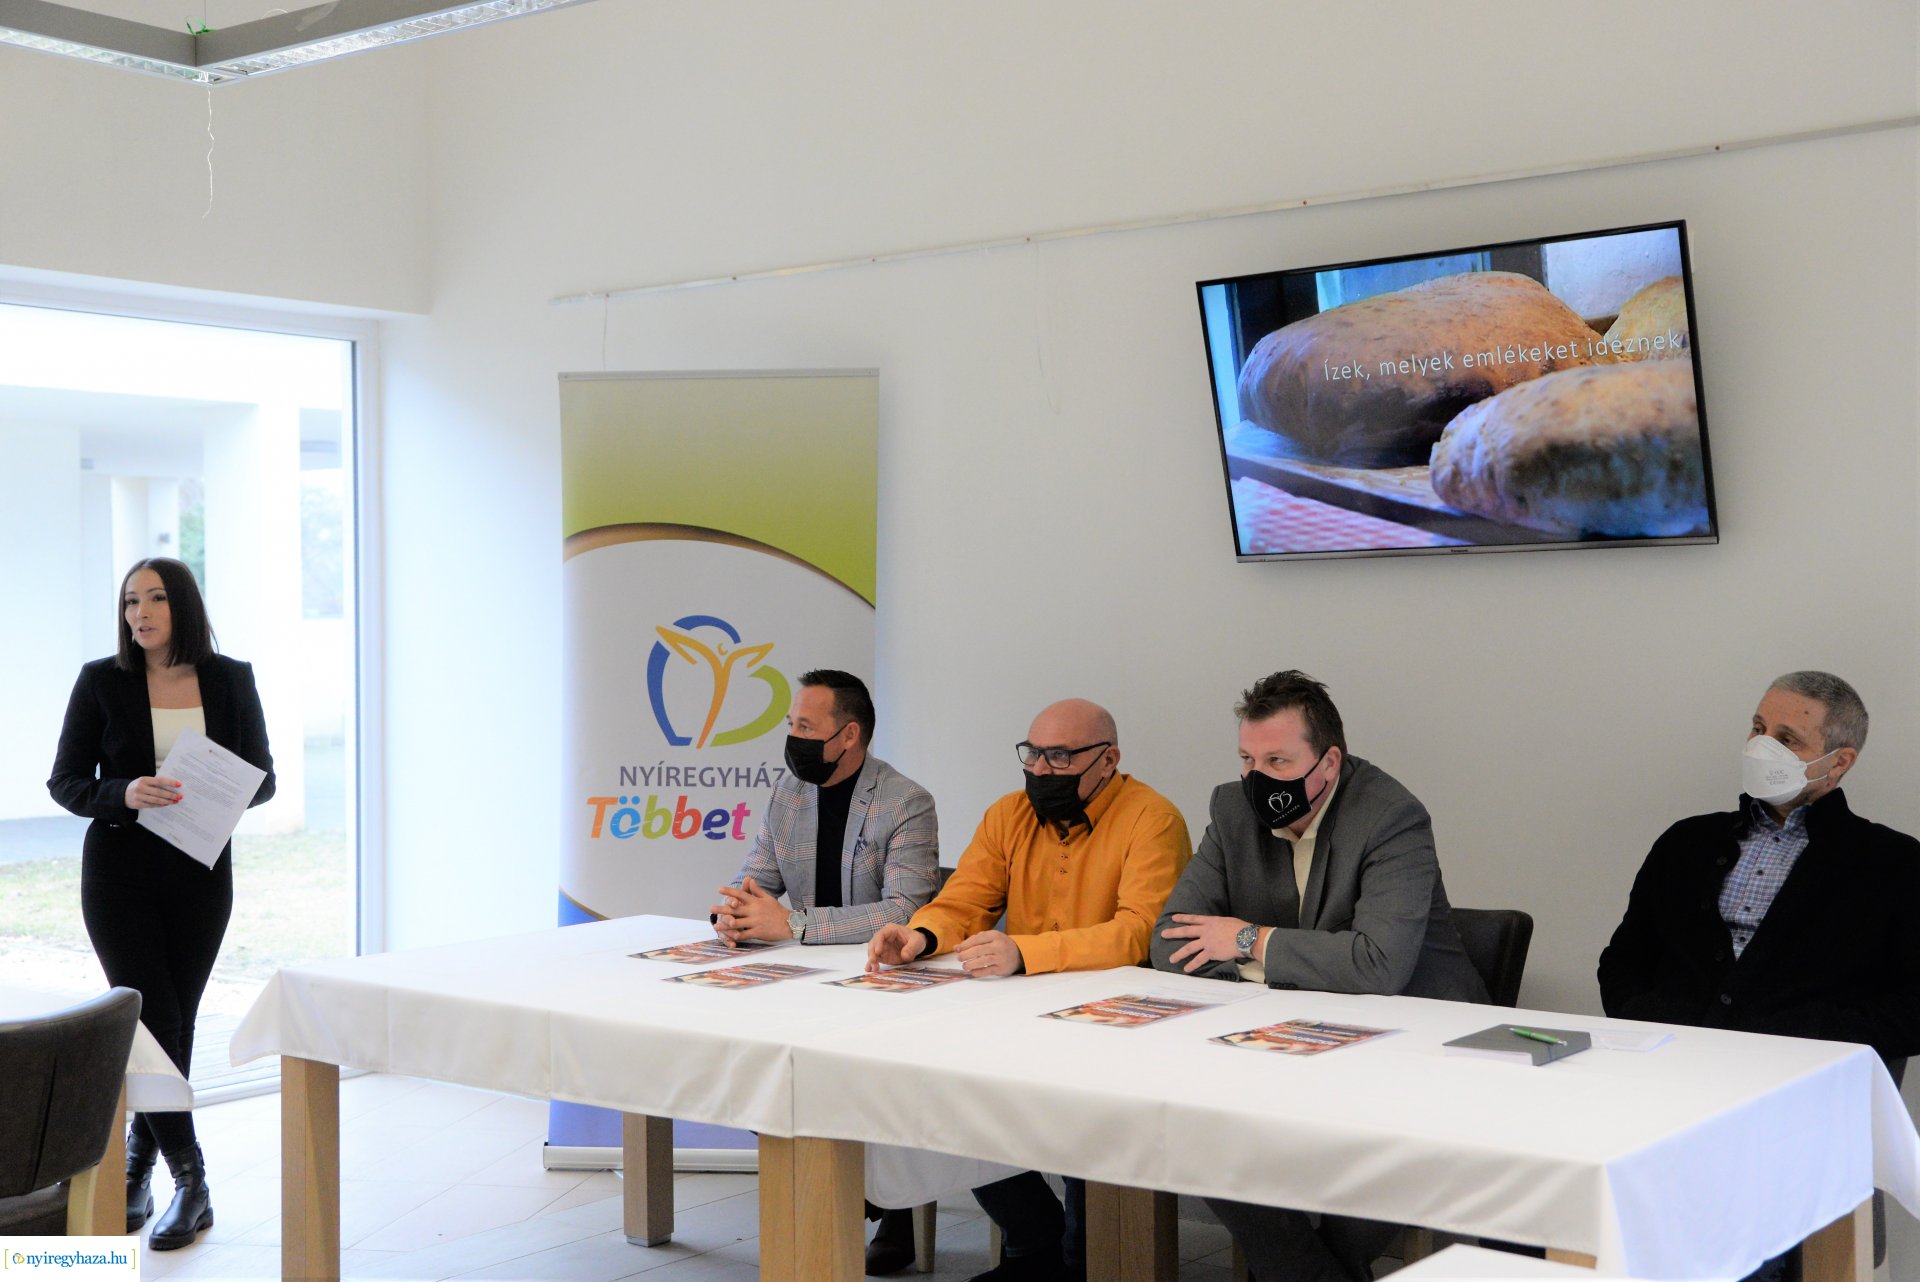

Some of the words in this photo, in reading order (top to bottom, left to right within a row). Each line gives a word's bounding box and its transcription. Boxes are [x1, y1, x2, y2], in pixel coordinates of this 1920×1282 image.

[1324, 358, 1371, 381] Ízek,
[1379, 351, 1454, 376] melyek
[1463, 341, 1578, 369] emlékeket
[1588, 328, 1681, 357] idéznek
[620, 761, 786, 788] NYÍREGYHÁZ
[587, 795, 751, 841] Többet
